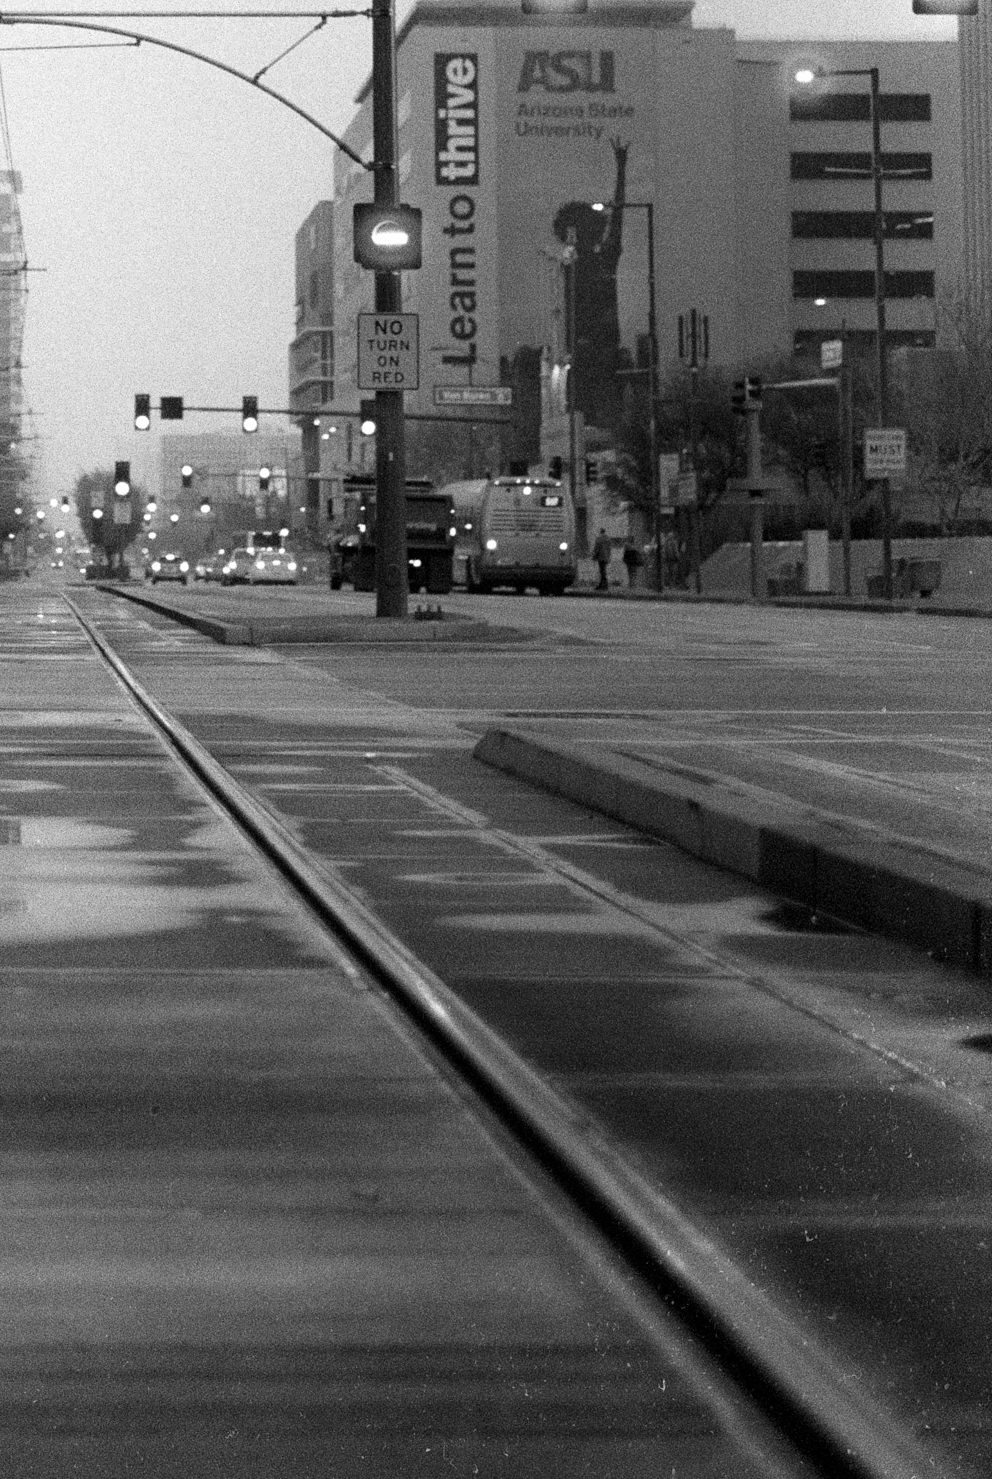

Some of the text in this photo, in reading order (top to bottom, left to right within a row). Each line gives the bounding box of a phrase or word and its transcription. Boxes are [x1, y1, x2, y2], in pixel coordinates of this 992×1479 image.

[517, 50, 616, 93] ASU
[517, 103, 634, 118] Arizona State
[515, 121, 604, 139] University
[438, 57, 477, 366] Learn to thrive
[375, 320, 403, 335] NO
[368, 339, 410, 351] TURN
[378, 355, 399, 367] ON
[372, 372, 404, 383] RED
[869, 444, 901, 455] MUST
